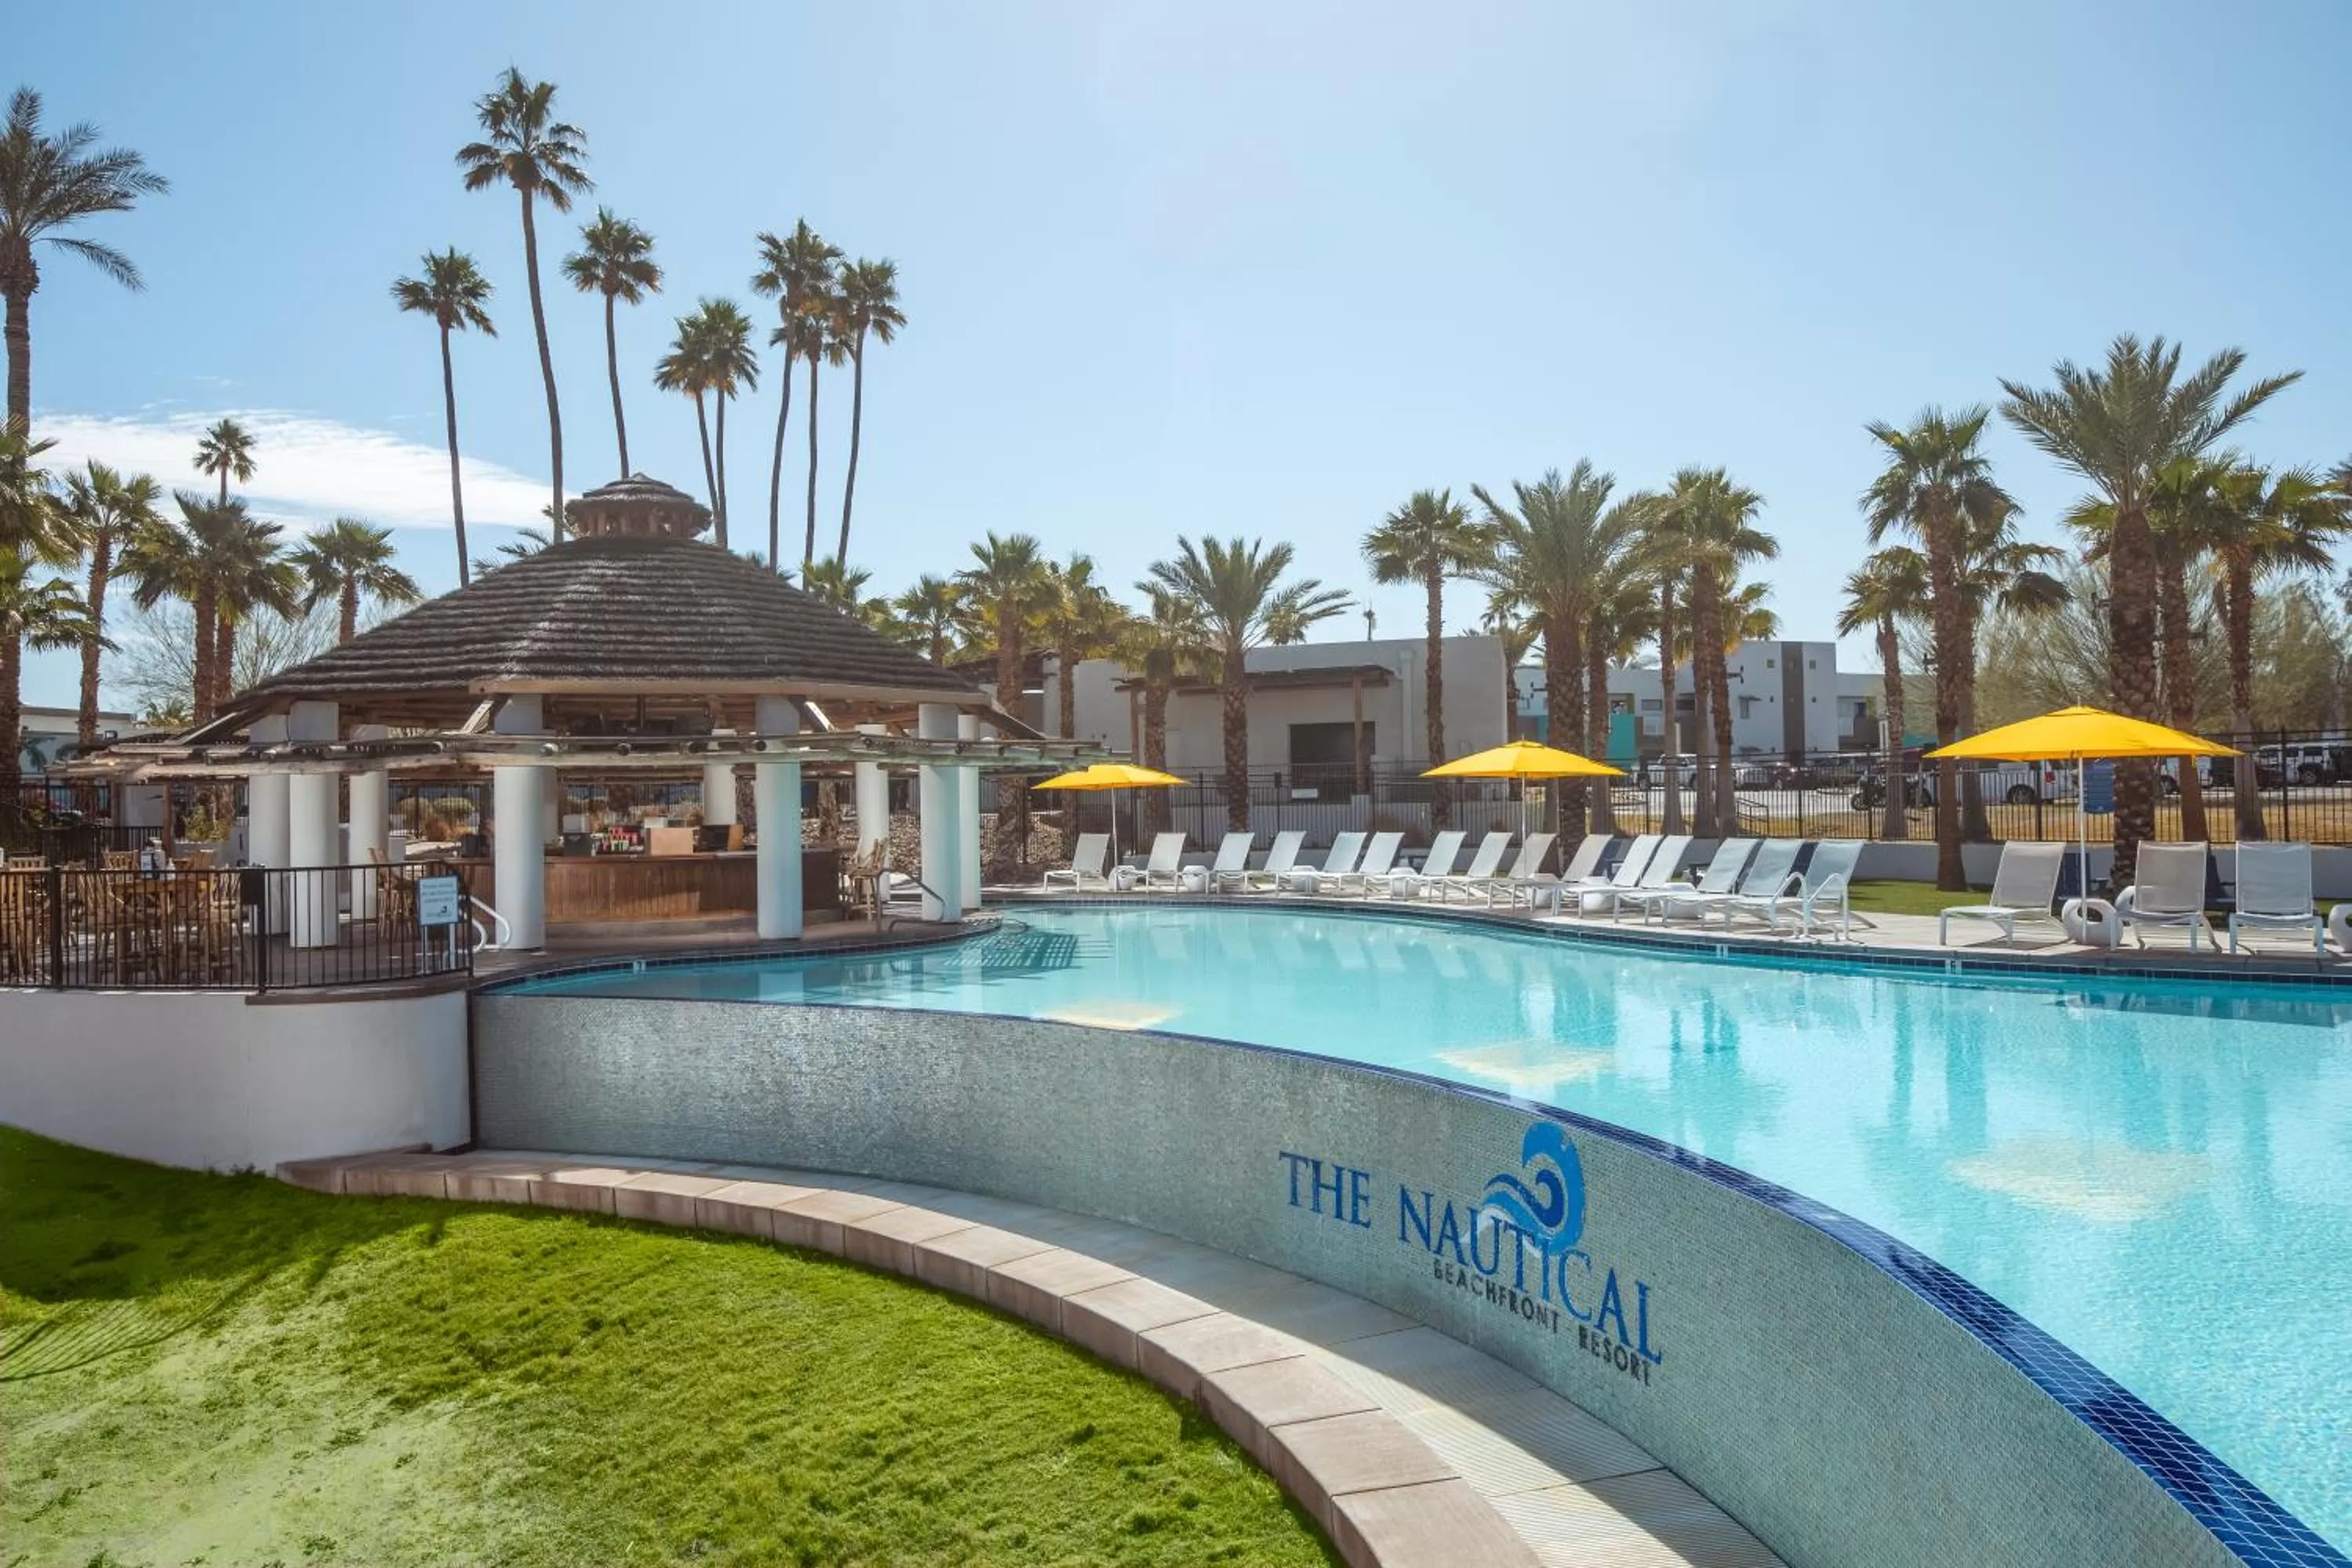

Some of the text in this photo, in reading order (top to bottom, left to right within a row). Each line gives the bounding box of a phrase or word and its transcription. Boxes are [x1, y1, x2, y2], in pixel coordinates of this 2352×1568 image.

[1279, 1151, 1662, 1365] THE NAUTICAL
[1433, 1258, 1650, 1386] BEACHFRONT RESORT
